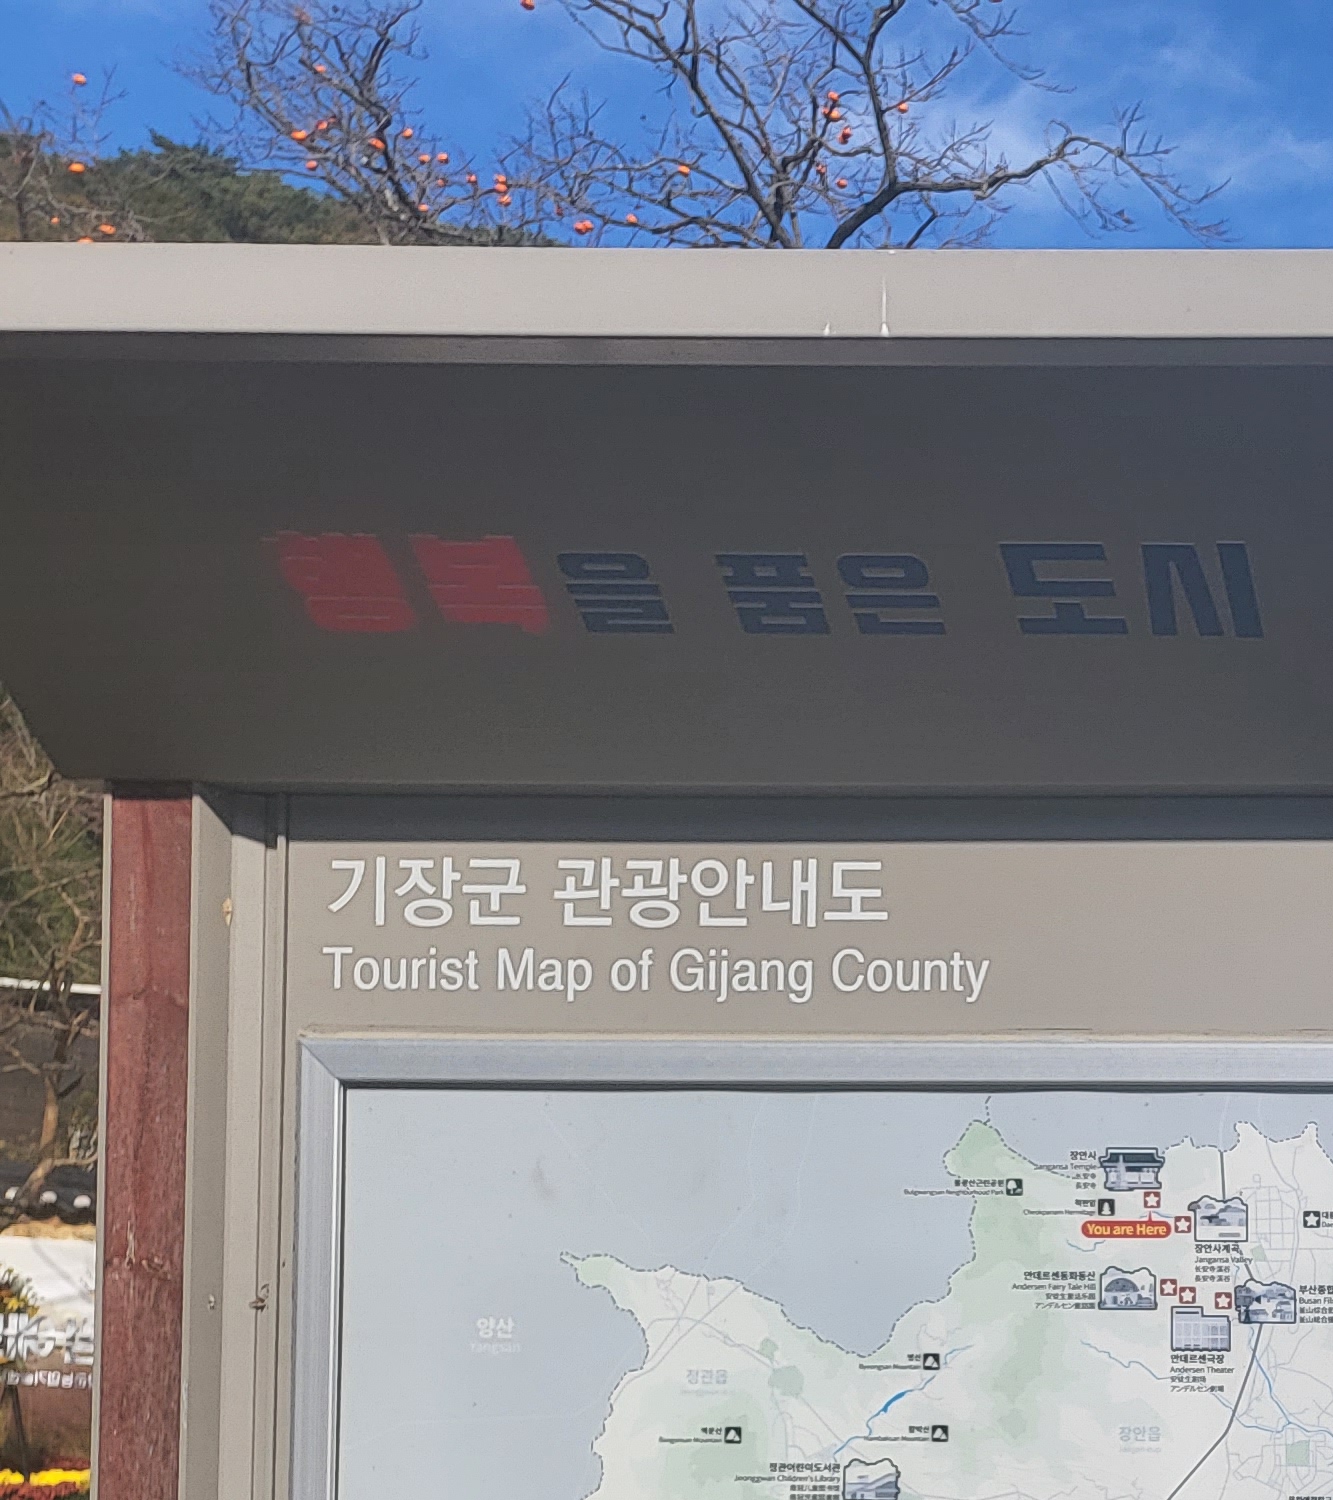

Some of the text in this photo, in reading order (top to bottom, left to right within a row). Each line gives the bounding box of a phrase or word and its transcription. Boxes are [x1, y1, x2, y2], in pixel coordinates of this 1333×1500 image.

[272, 530, 1266, 640] 행복을 품은 도시
[328, 856, 889, 930] 기장군 관광안내도
[323, 946, 991, 1004] Tourist Map of Gijang County
[1070, 1151, 1096, 1160] 장안사
[1088, 1222, 1167, 1236] You are Here
[1195, 1244, 1240, 1254] 장안사계곡
[1195, 1255, 1253, 1266] Jangansa Valley
[477, 1315, 514, 1338] 양산
[1171, 1354, 1224, 1364] 안데르센극장
[1170, 1366, 1205, 1375] Andersen
[1119, 1426, 1161, 1442] 장안읍
